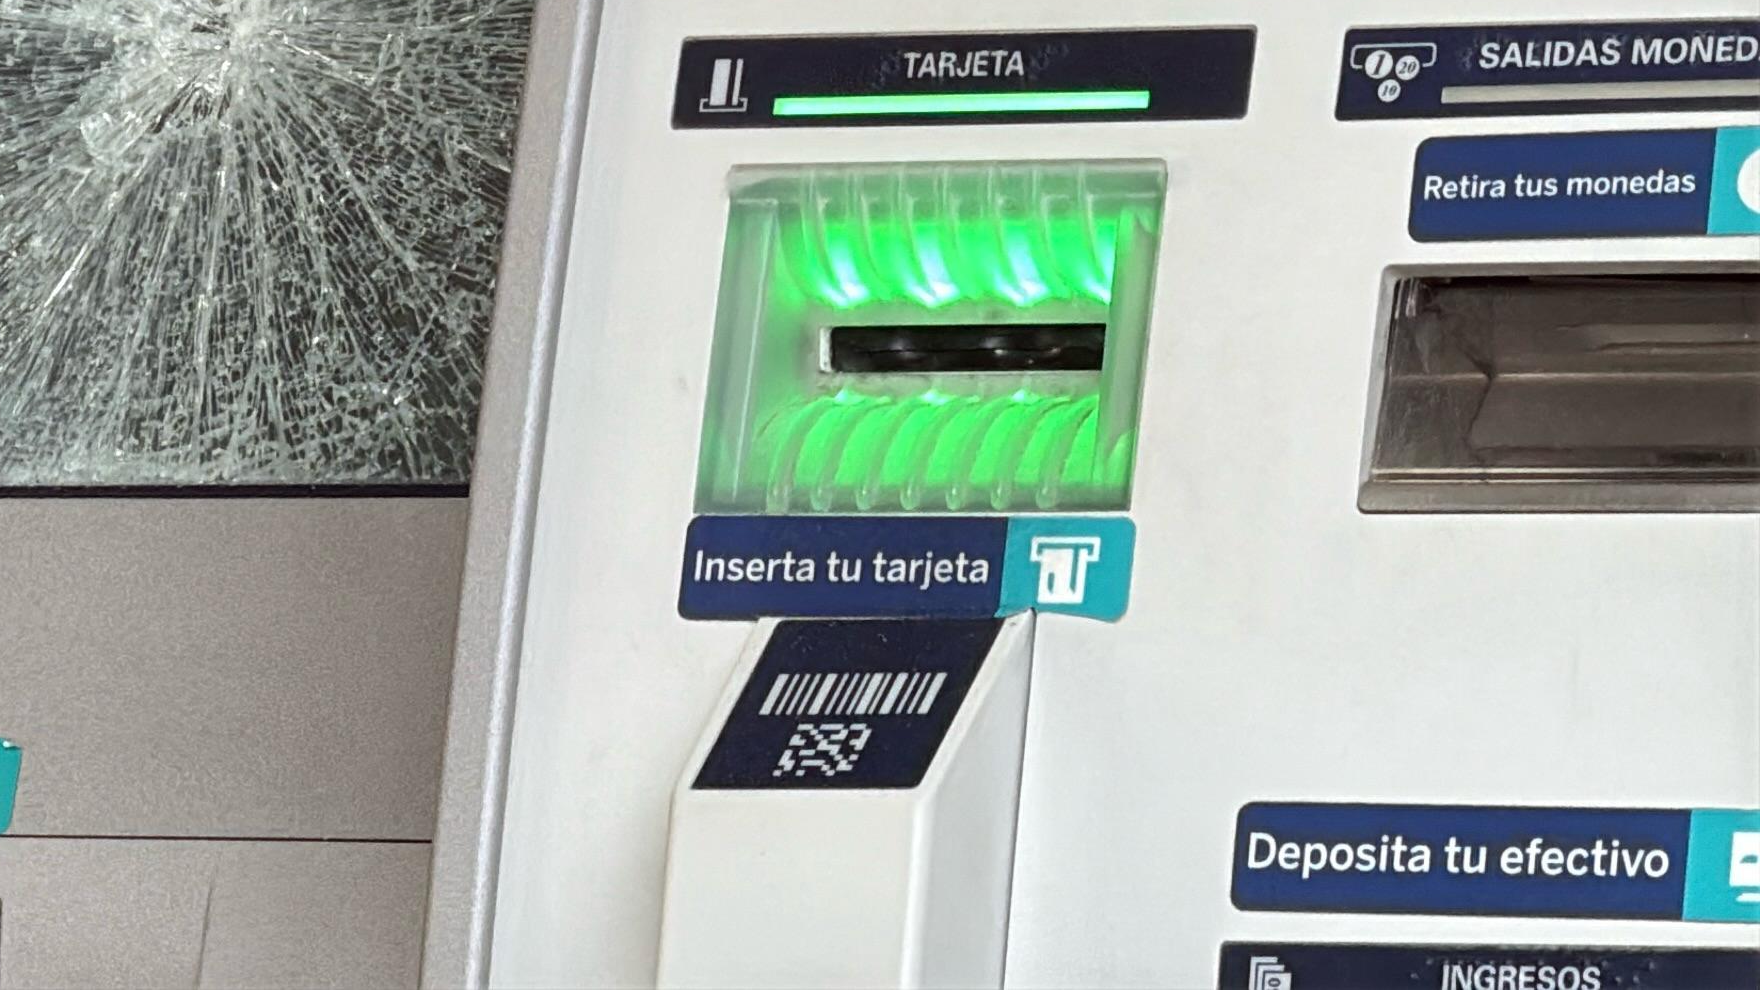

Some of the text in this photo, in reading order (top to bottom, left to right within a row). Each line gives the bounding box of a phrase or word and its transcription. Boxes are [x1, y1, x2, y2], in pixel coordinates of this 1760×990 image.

[904, 50, 1025, 79] TARJETA
[1479, 35, 1760, 69] SALIDAS MONED
[1398, 60, 1417, 76] 20
[1381, 84, 1398, 98] 10
[1423, 168, 1696, 200] Retira tus monedas
[694, 549, 990, 591] Inserta tu tarjeta
[1246, 831, 1670, 879] Deposita tu efectivo
[1441, 963, 1601, 990] INGRESOS
